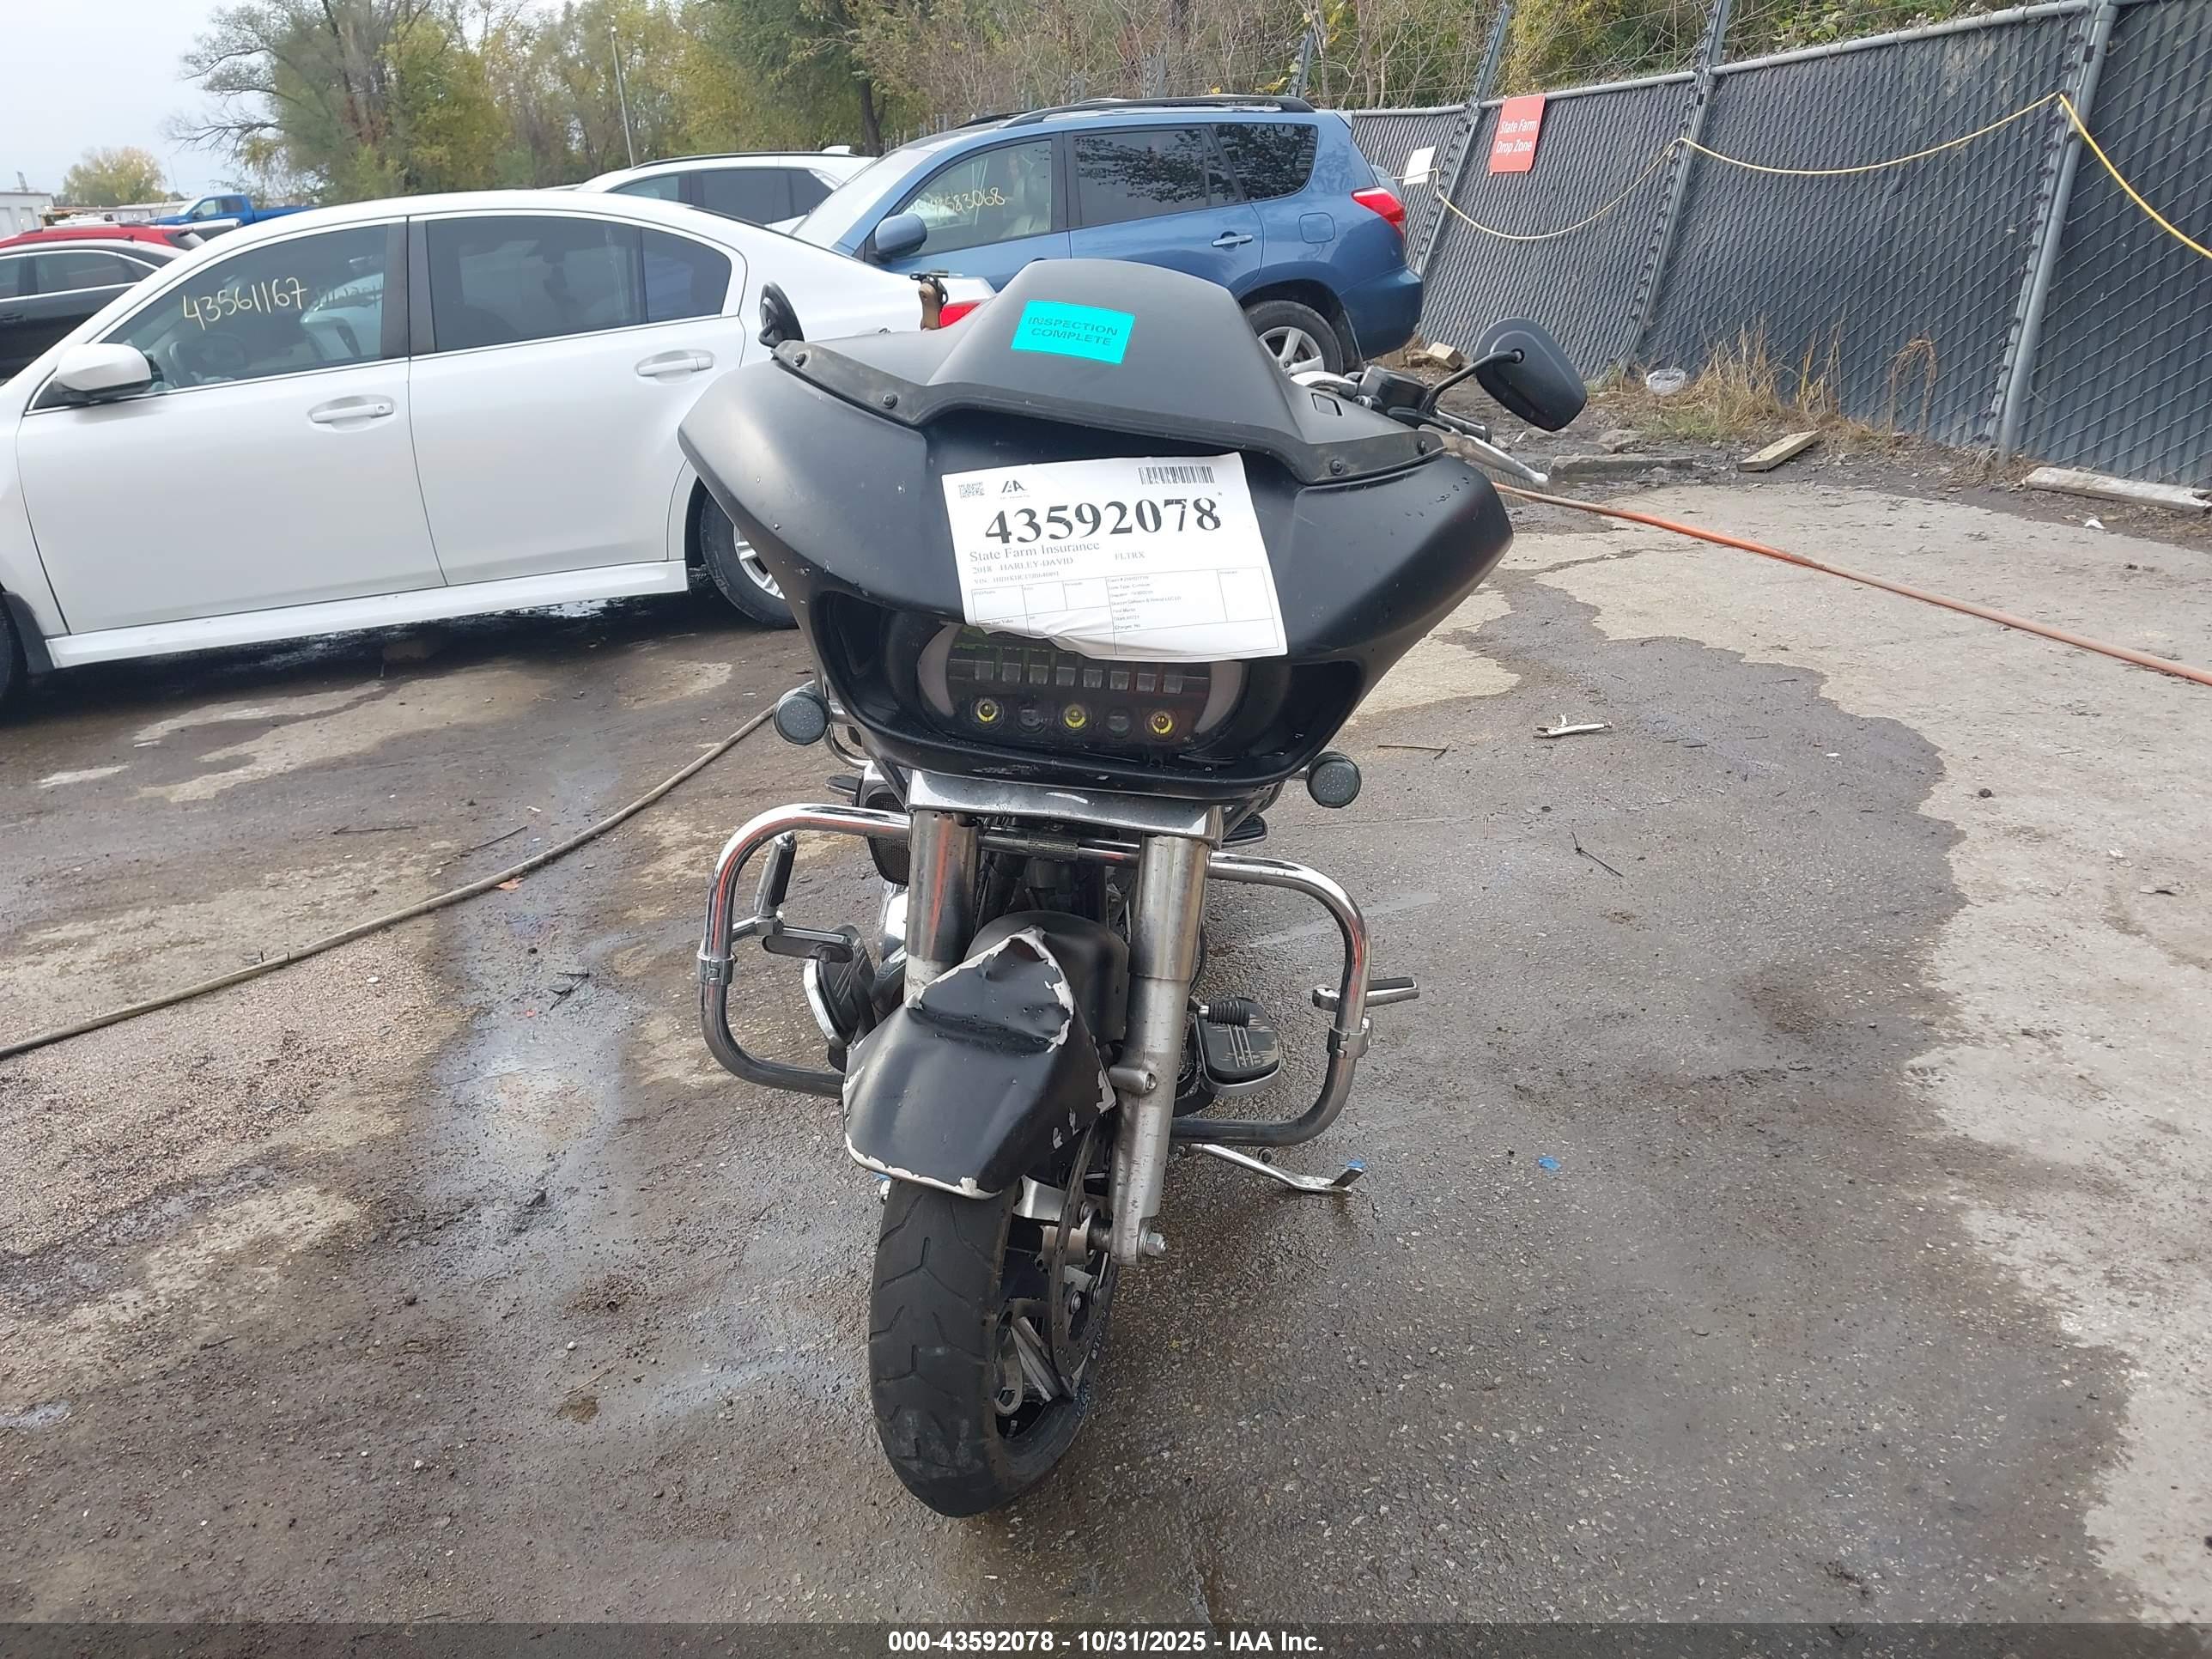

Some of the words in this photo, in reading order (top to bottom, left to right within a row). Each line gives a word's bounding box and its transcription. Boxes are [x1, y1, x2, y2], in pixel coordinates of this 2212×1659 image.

[1499, 120, 1518, 134] State
[1518, 118, 1537, 132] Farm
[1496, 141, 1513, 155] Drop
[1514, 139, 1533, 152] Zone
[183, 276, 307, 331] 43561167
[1027, 317, 1118, 336] INSPECTION
[1031, 328, 1112, 346] COMPLETE
[985, 498, 1221, 544] 43592078
[969, 550, 1001, 562] State
[1004, 545, 1037, 558] Farm
[1041, 541, 1100, 555] Insurance
